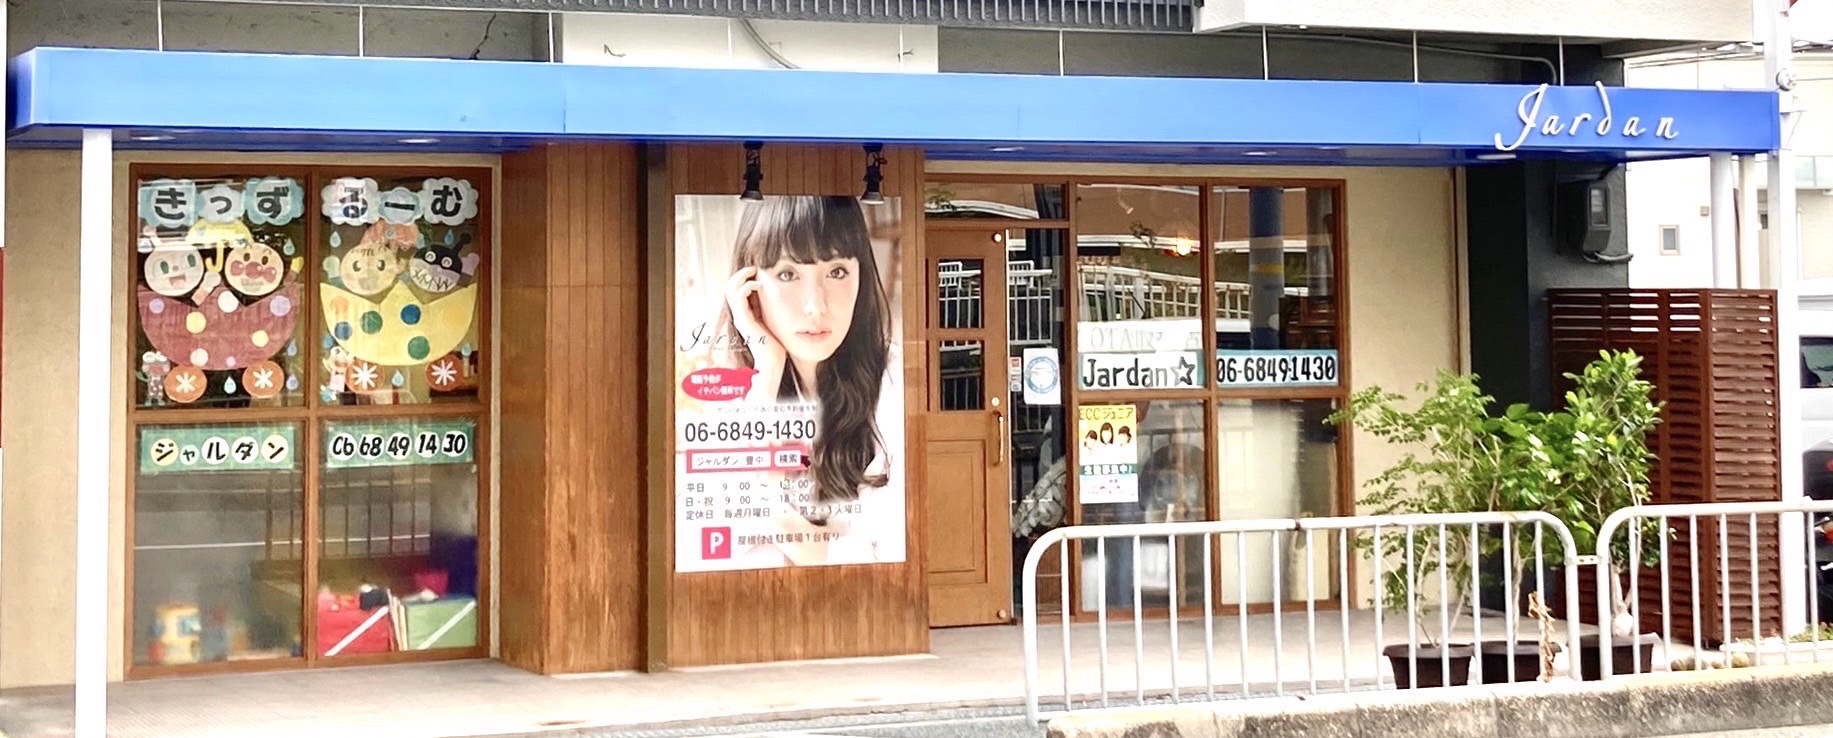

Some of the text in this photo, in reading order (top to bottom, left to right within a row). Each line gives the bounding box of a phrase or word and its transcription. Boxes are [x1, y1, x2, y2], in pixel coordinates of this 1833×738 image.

[1494, 80, 1679, 151] Jardan
[154, 187, 290, 220] きっず
[1083, 358, 1168, 387] Jardan
[685, 419, 816, 442] 06-6849-1430
[155, 442, 284, 462] ジャルダン
[697, 456, 739, 466] ジャルダン
[779, 454, 798, 463] 検索
[686, 510, 714, 520] 定休日
[710, 531, 724, 555] P
